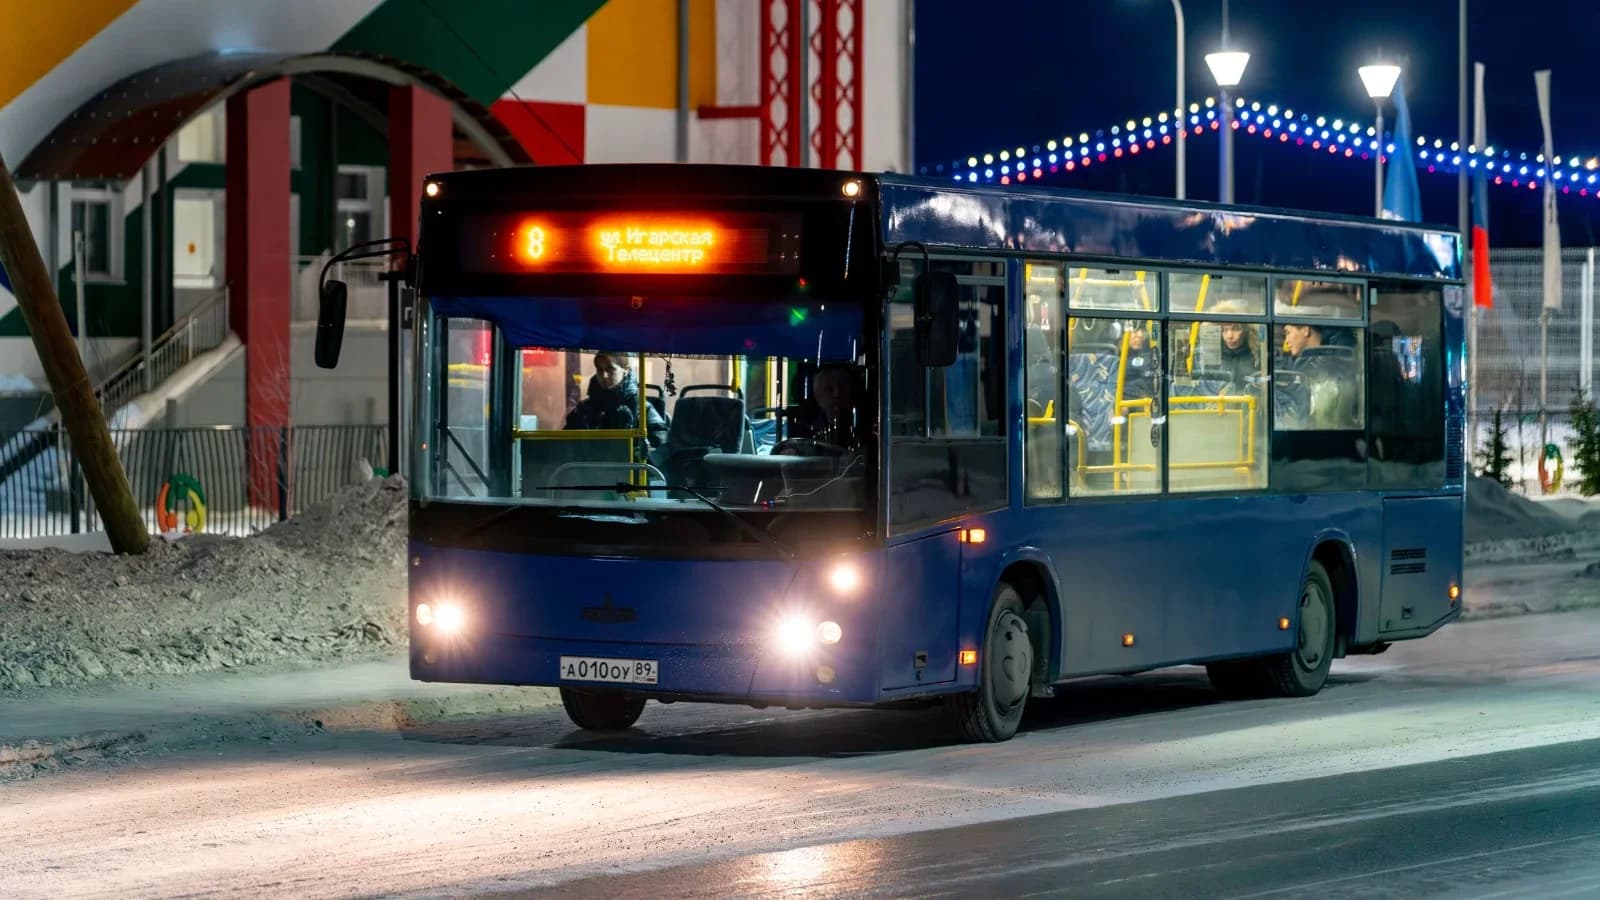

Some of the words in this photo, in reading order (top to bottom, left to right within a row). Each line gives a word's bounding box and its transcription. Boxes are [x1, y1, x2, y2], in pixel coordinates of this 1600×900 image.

[527, 226, 545, 259] 8
[626, 227, 713, 246] Игарская
[606, 245, 705, 264] Телецентр
[635, 662, 652, 676] 89
